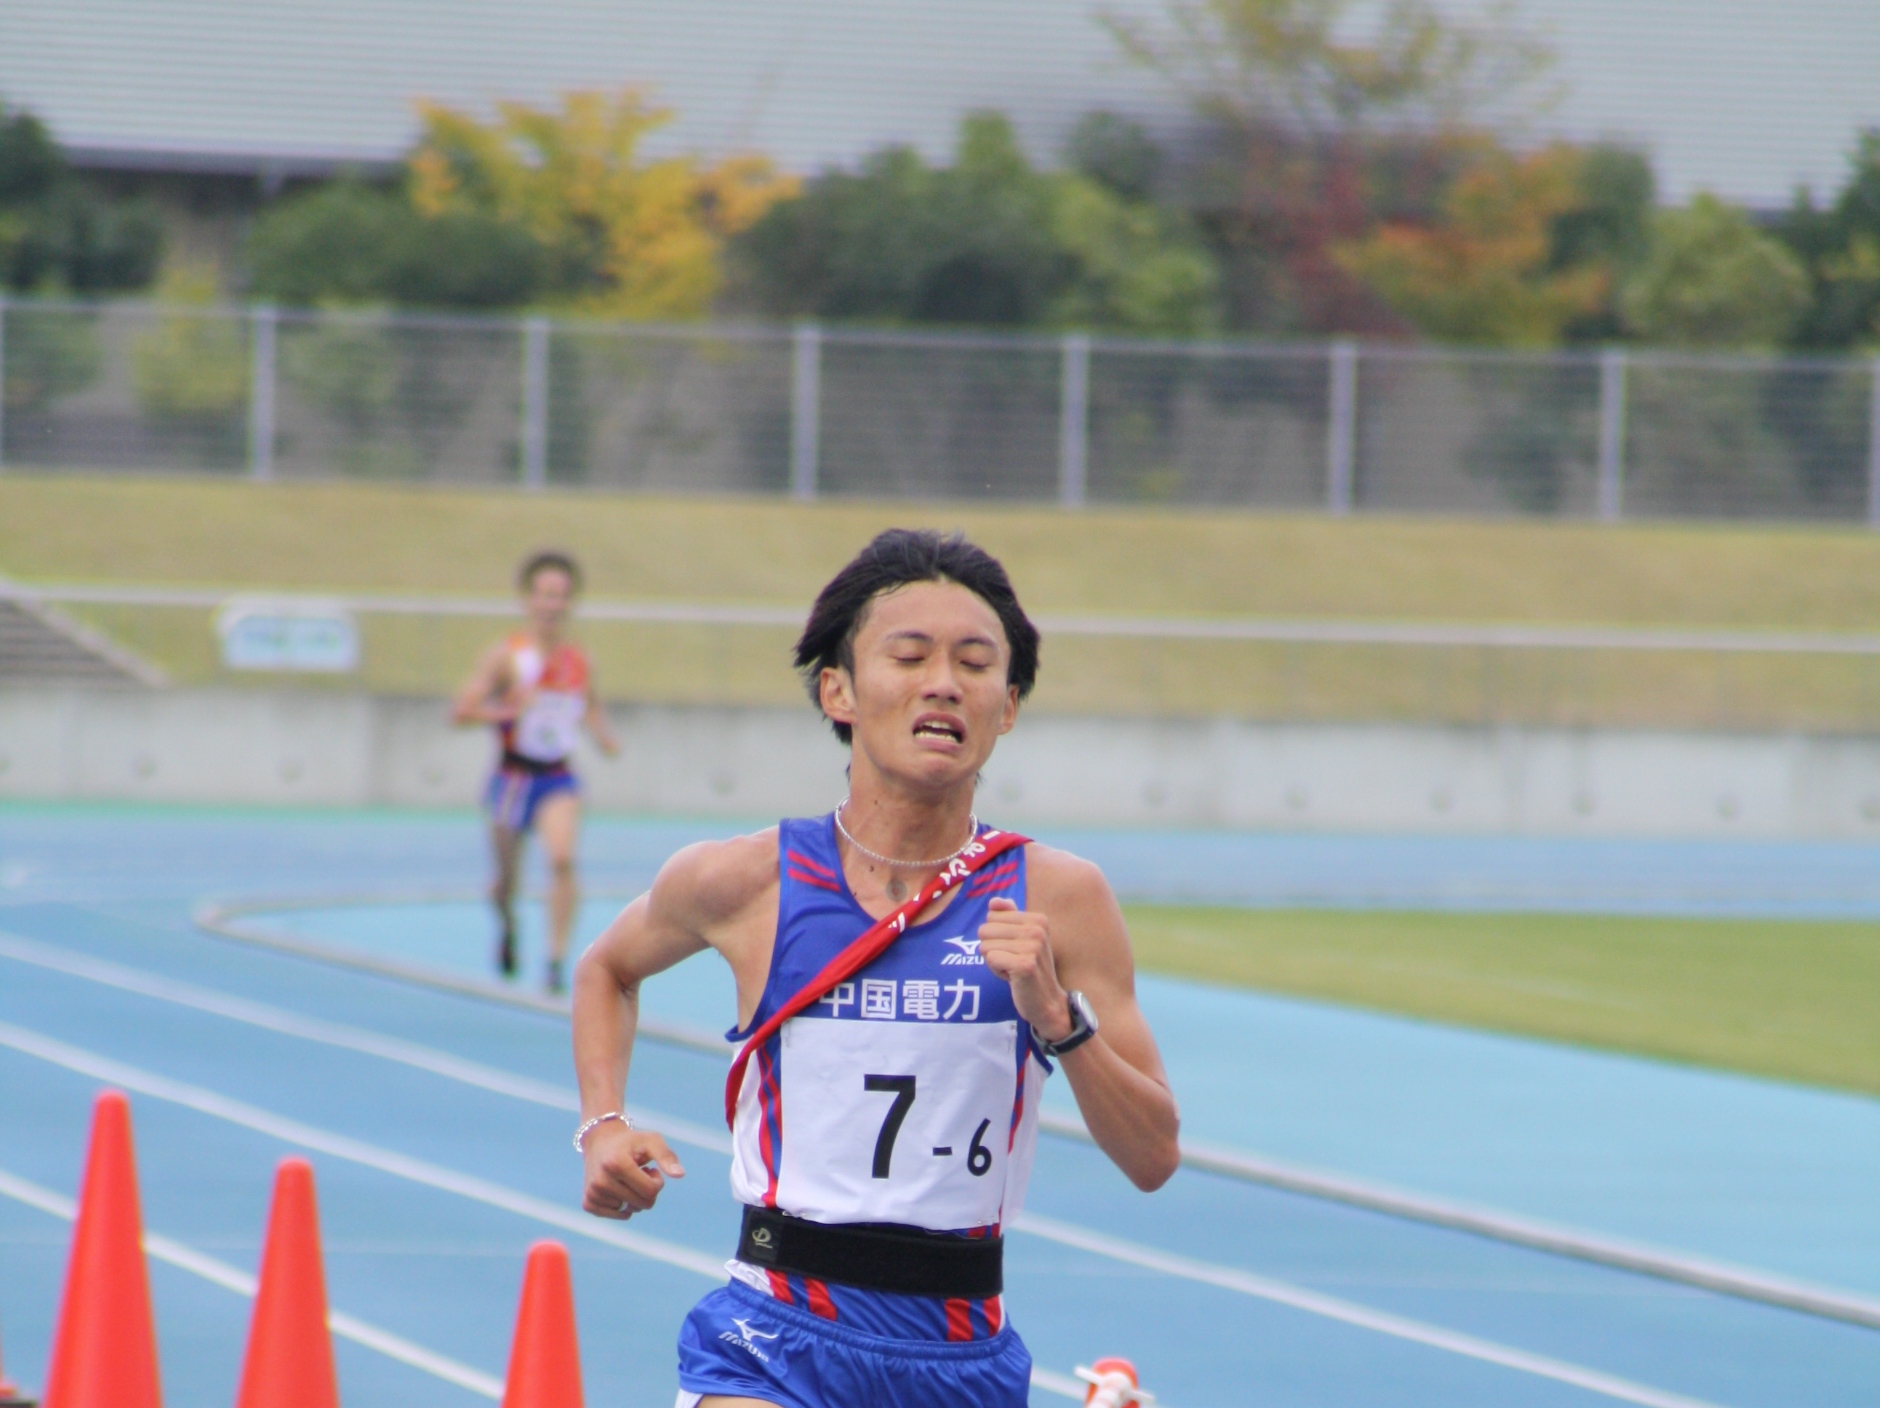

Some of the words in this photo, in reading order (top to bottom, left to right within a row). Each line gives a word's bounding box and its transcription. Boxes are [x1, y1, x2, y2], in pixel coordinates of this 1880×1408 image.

[819, 979, 981, 1020] 中国電力
[864, 1074, 992, 1179] 7-6
